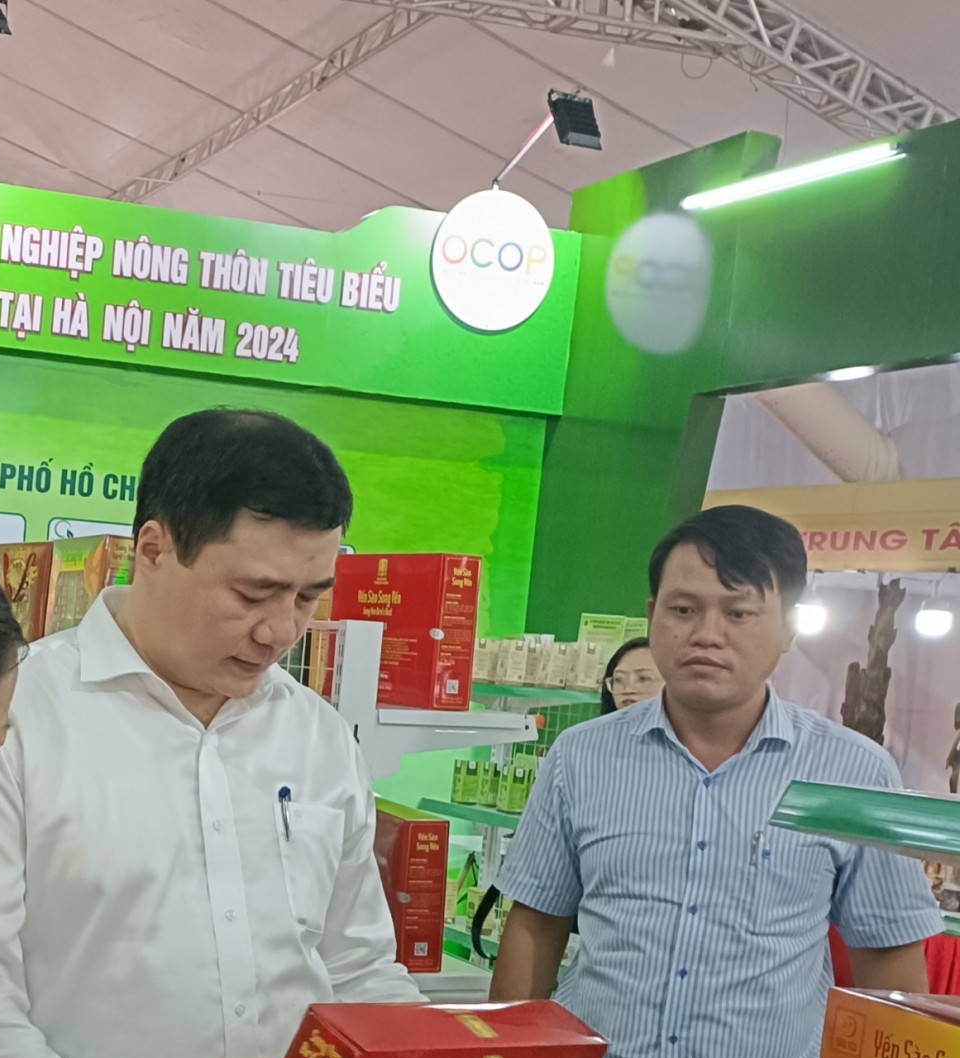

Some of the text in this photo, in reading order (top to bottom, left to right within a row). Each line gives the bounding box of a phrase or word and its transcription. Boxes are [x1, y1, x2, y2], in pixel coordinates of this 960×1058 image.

[0, 225, 104, 281] NGHIỆP
[112, 234, 189, 286] NÔNG
[199, 248, 269, 296] THÔN
[278, 257, 335, 304] TIÊU
[340, 260, 401, 313] BIỂU
[441, 234, 548, 274] OCOP
[51, 291, 89, 339] HÀ
[102, 299, 152, 352] NỘI
[162, 306, 226, 355] NĂM
[235, 322, 300, 364] 2024
[0, 458, 54, 494] PHỐ
[60, 462, 95, 498] HỒ
[102, 473, 136, 502] CH
